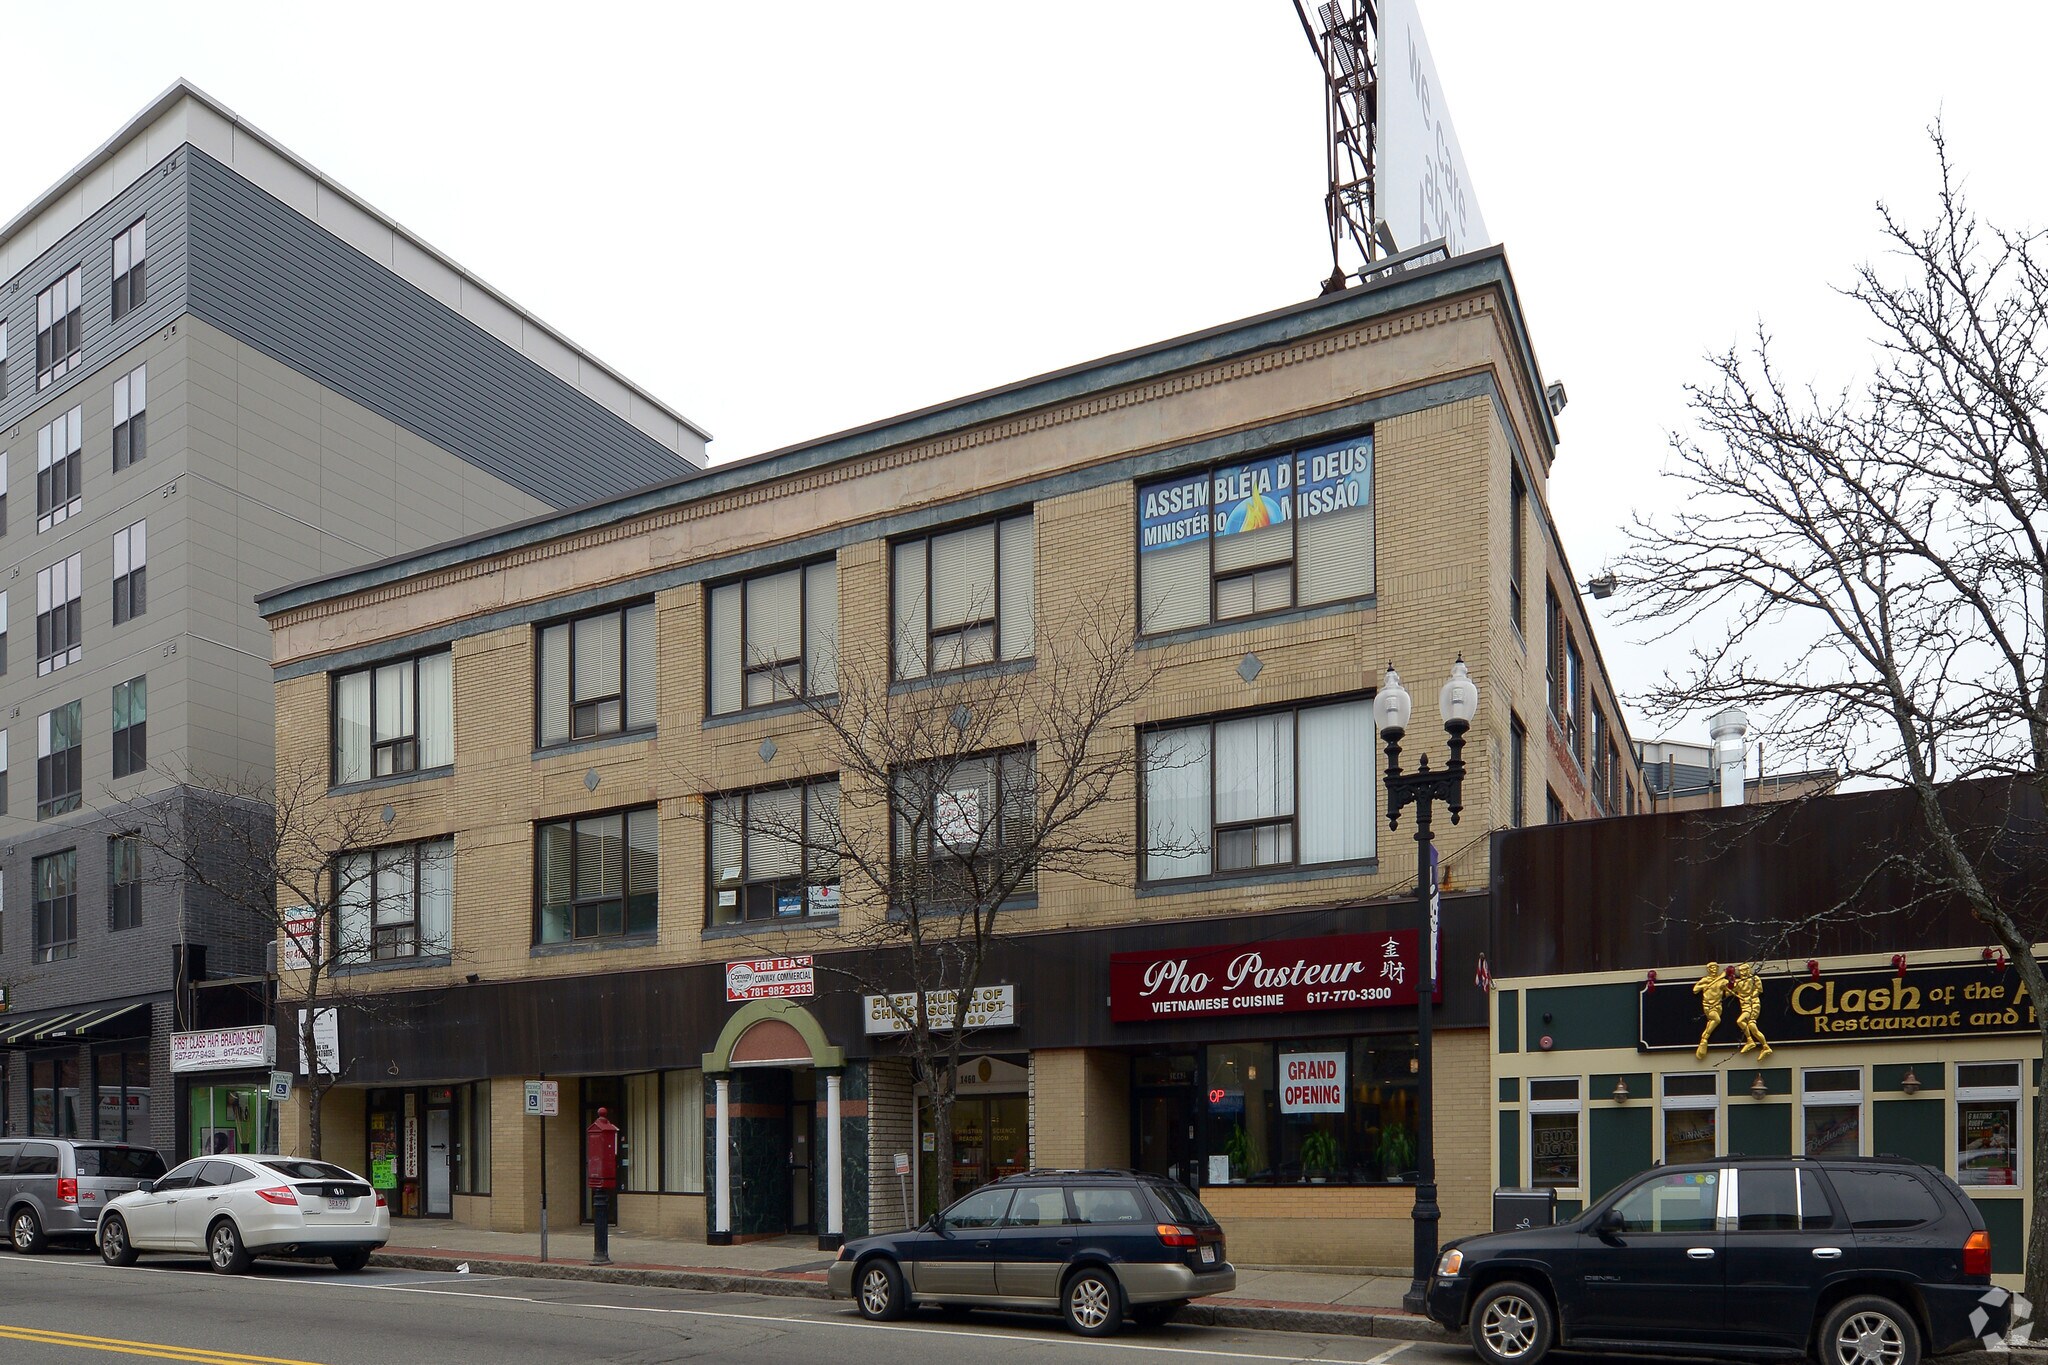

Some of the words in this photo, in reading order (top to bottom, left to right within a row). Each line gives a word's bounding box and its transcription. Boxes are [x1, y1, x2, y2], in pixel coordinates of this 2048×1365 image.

[1145, 467, 1271, 519] ASSEMBLÉIA
[1277, 461, 1305, 490] DE
[1312, 446, 1367, 483] DEUS
[754, 961, 773, 971] FOR
[778, 958, 810, 969] LEASE
[731, 973, 752, 981] Conway
[755, 974, 776, 983] CONWAY
[777, 971, 812, 982] COMMERCIAL
[1139, 959, 1214, 997] Pho
[1222, 952, 1365, 991] Pasteur
[750, 984, 812, 997] 781-982-2333
[982, 989, 1003, 1001] OF
[1791, 978, 1921, 1015] Clash
[1929, 985, 1955, 1004] of
[1963, 981, 2005, 1000] the
[1152, 997, 1229, 1013] VIETNAMESE
[1232, 994, 1284, 1008] CUISINE
[1306, 988, 1392, 1004] 617-770-3300
[1814, 1010, 1961, 1033] Restaurant
[1969, 1007, 2019, 1026] and
[190, 1035, 206, 1049] CLASS
[1288, 1061, 1337, 1081] GRAND
[961, 1075, 976, 1083] 1460
[1285, 1085, 1340, 1105] OPENING
[1541, 1130, 1573, 1144] BUD
[1535, 1142, 1578, 1156] LIGHT
